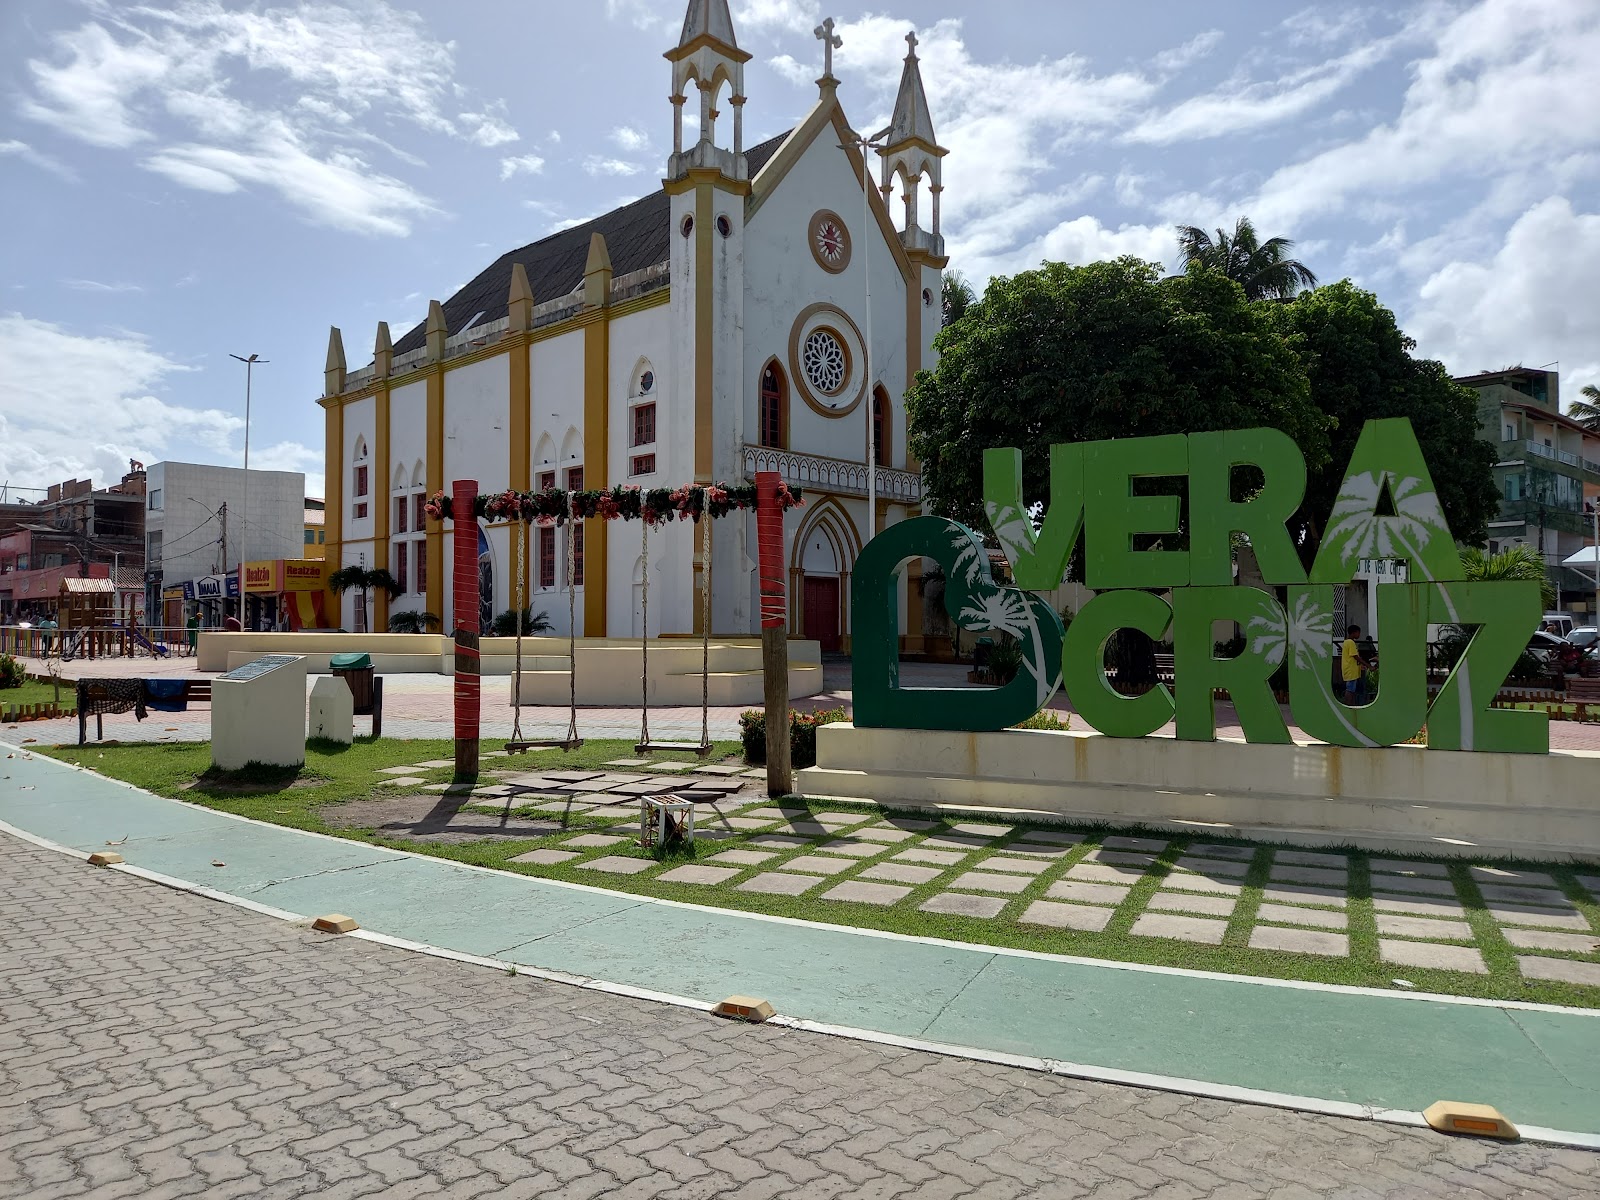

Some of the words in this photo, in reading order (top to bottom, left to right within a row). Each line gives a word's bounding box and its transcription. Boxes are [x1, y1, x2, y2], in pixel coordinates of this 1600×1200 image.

[983, 417, 1464, 591] VERA
[287, 566, 320, 575] Realzão
[1365, 560, 1370, 573] DE
[1375, 561, 1386, 574] VERA
[1062, 581, 1550, 755] CRUZ
